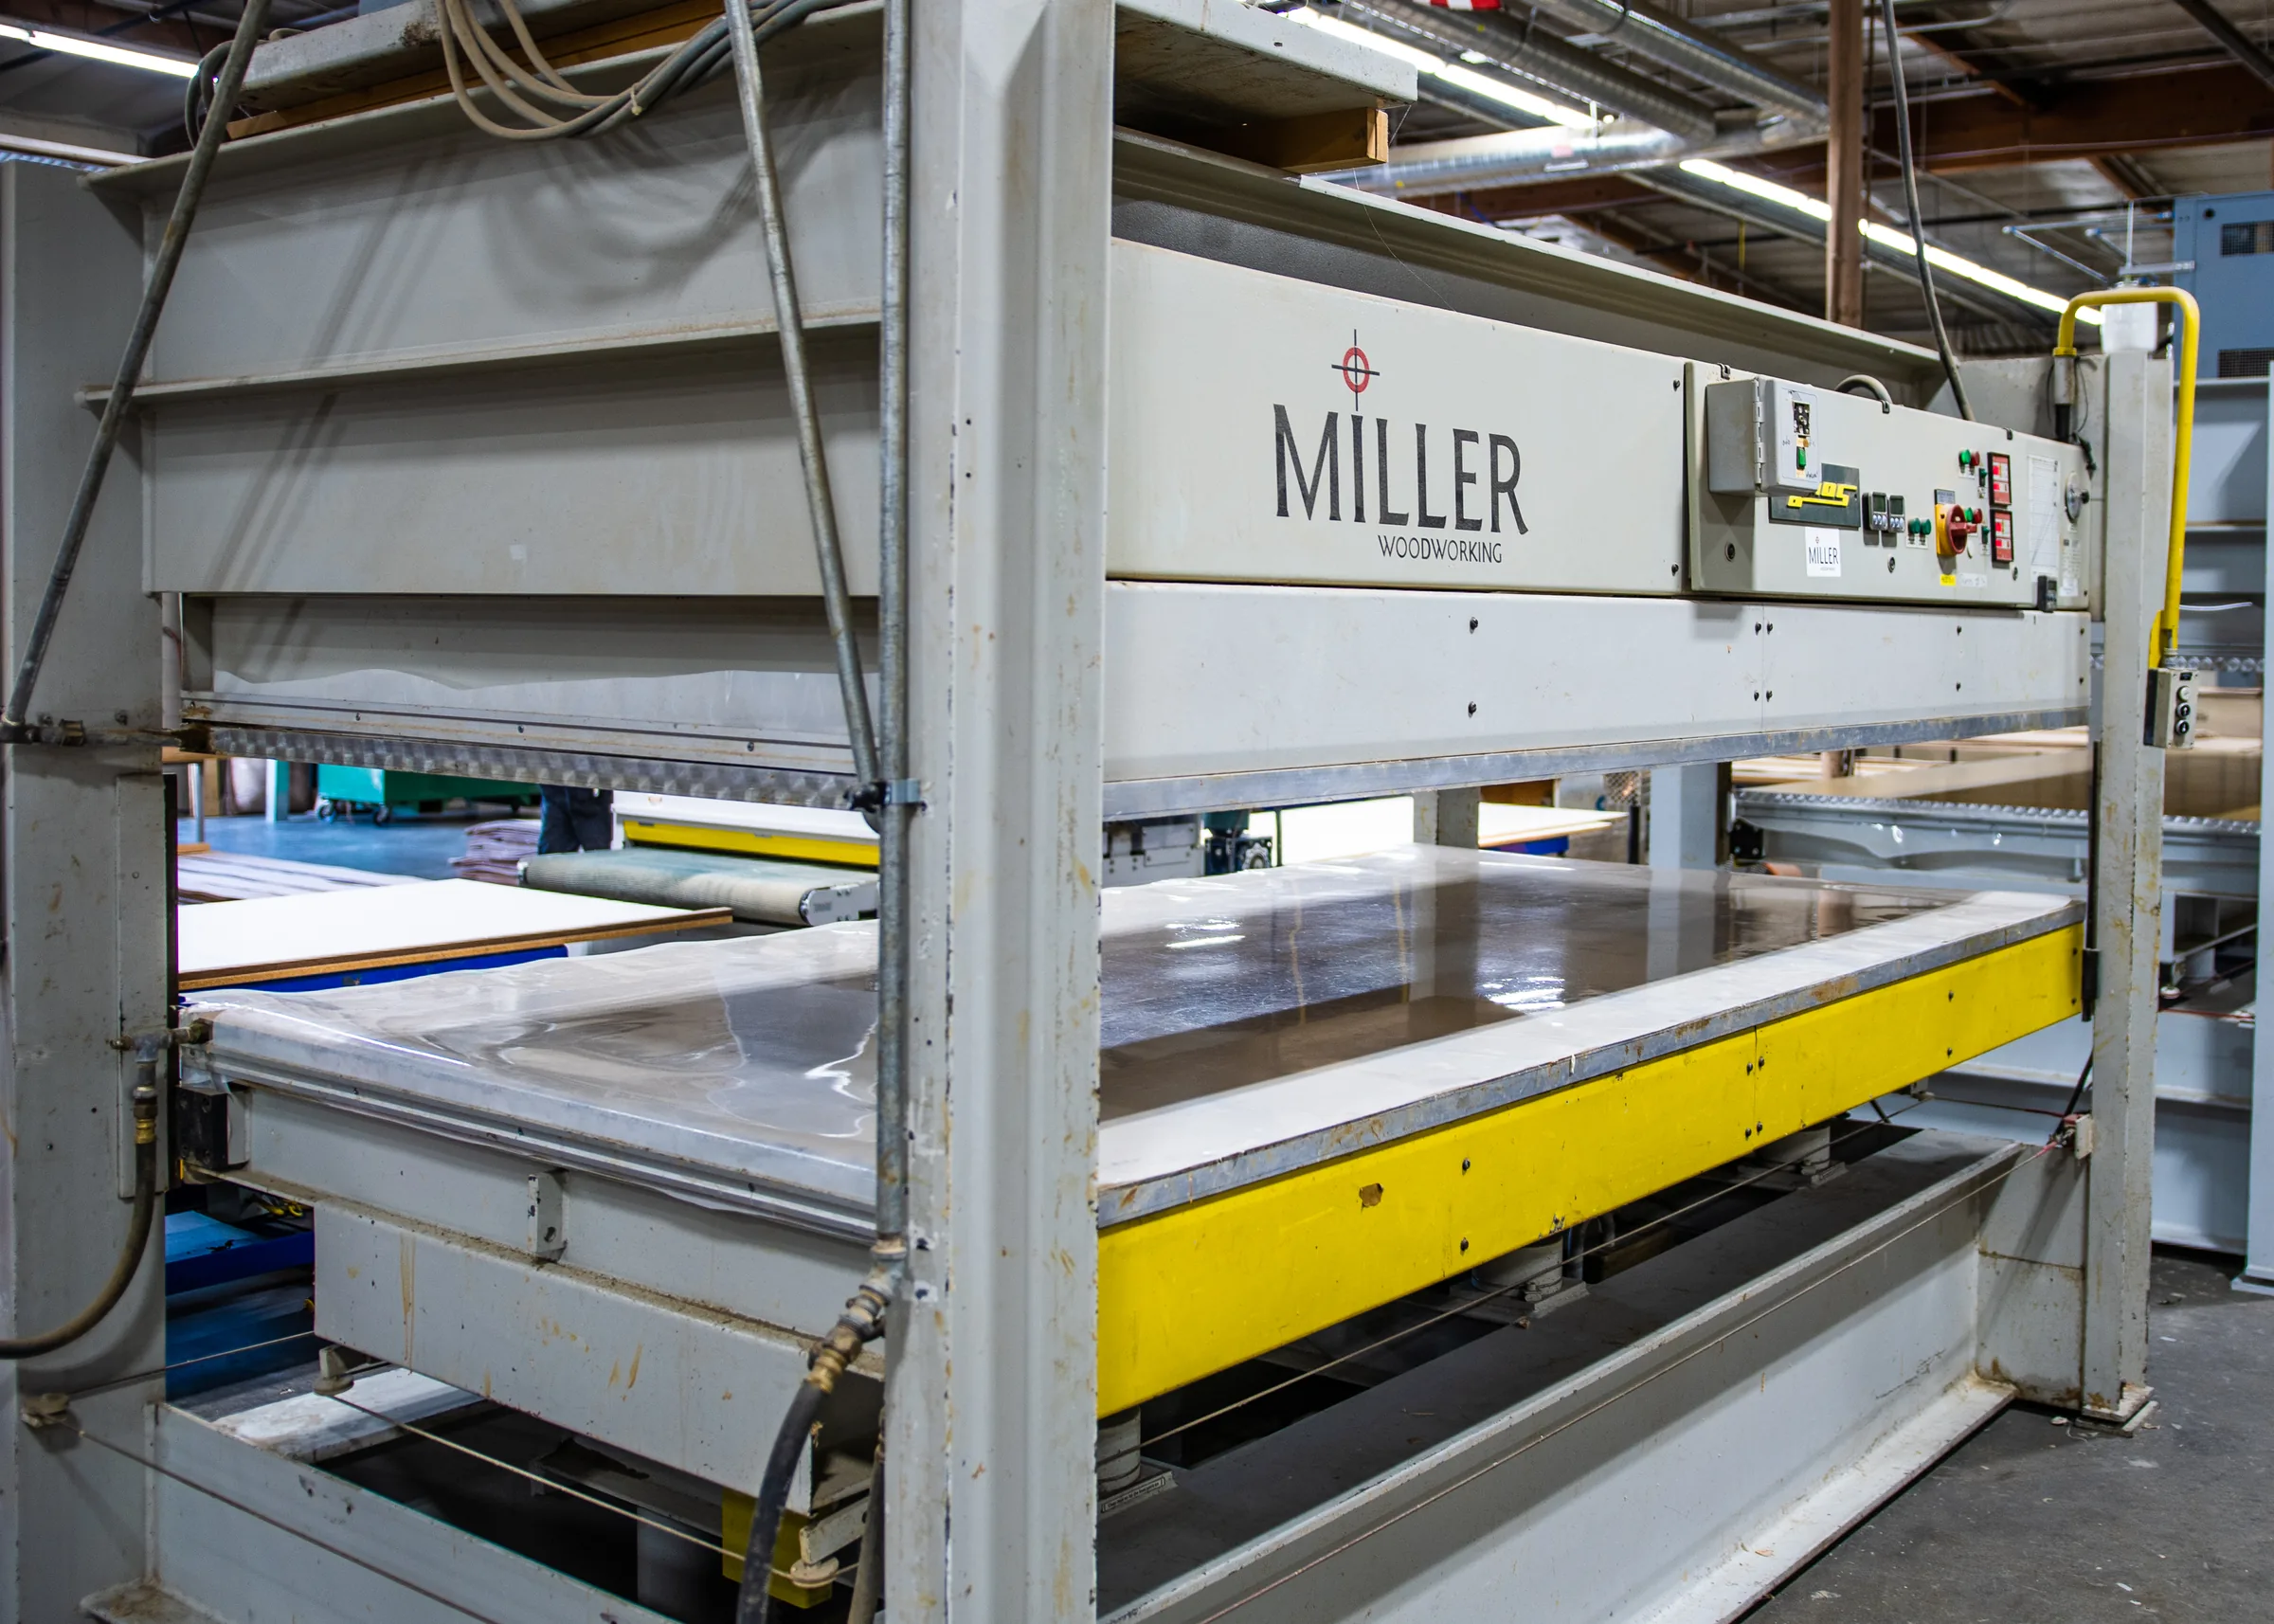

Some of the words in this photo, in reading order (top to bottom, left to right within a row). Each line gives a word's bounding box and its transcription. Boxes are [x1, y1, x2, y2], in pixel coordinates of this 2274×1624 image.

[1272, 404, 1528, 535] MILLER
[1378, 534, 1503, 564] WOODWORKING
[1808, 546, 1839, 565] MILLER
